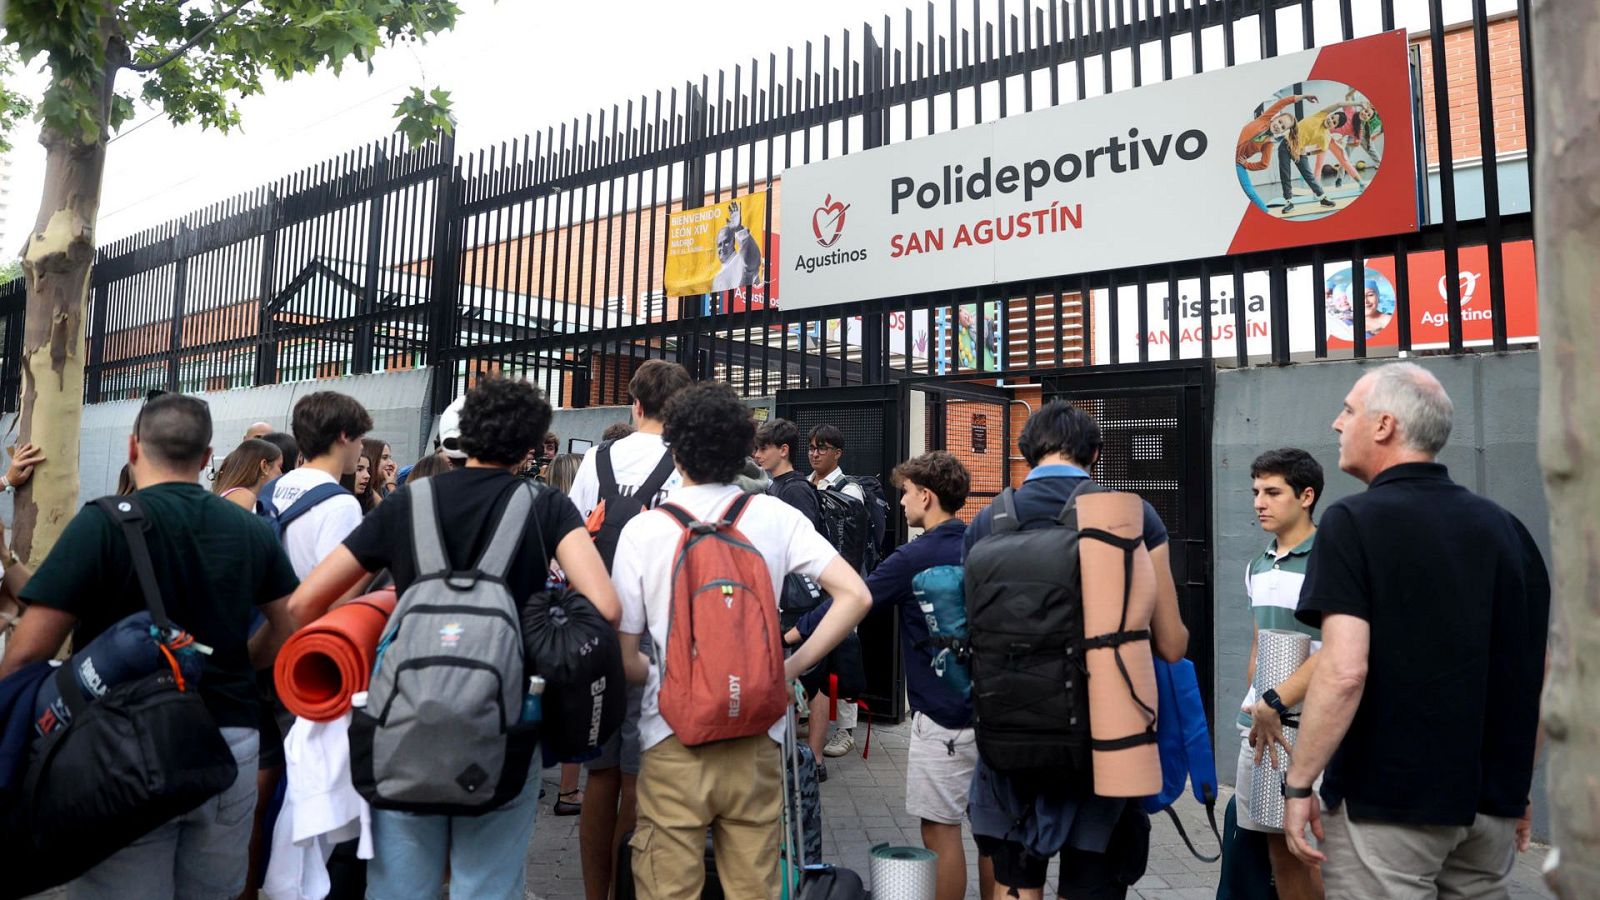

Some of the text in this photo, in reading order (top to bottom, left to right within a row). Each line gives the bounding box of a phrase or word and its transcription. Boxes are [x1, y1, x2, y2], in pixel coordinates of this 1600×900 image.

[891, 128, 1208, 214] Polideportivo
[671, 224, 709, 239] LEÓN XIV
[672, 208, 721, 226] BIENVENIDO
[890, 200, 1083, 258] SAN AGUSTÍN
[795, 247, 867, 273] Agustinos
[728, 674, 741, 717] READY
